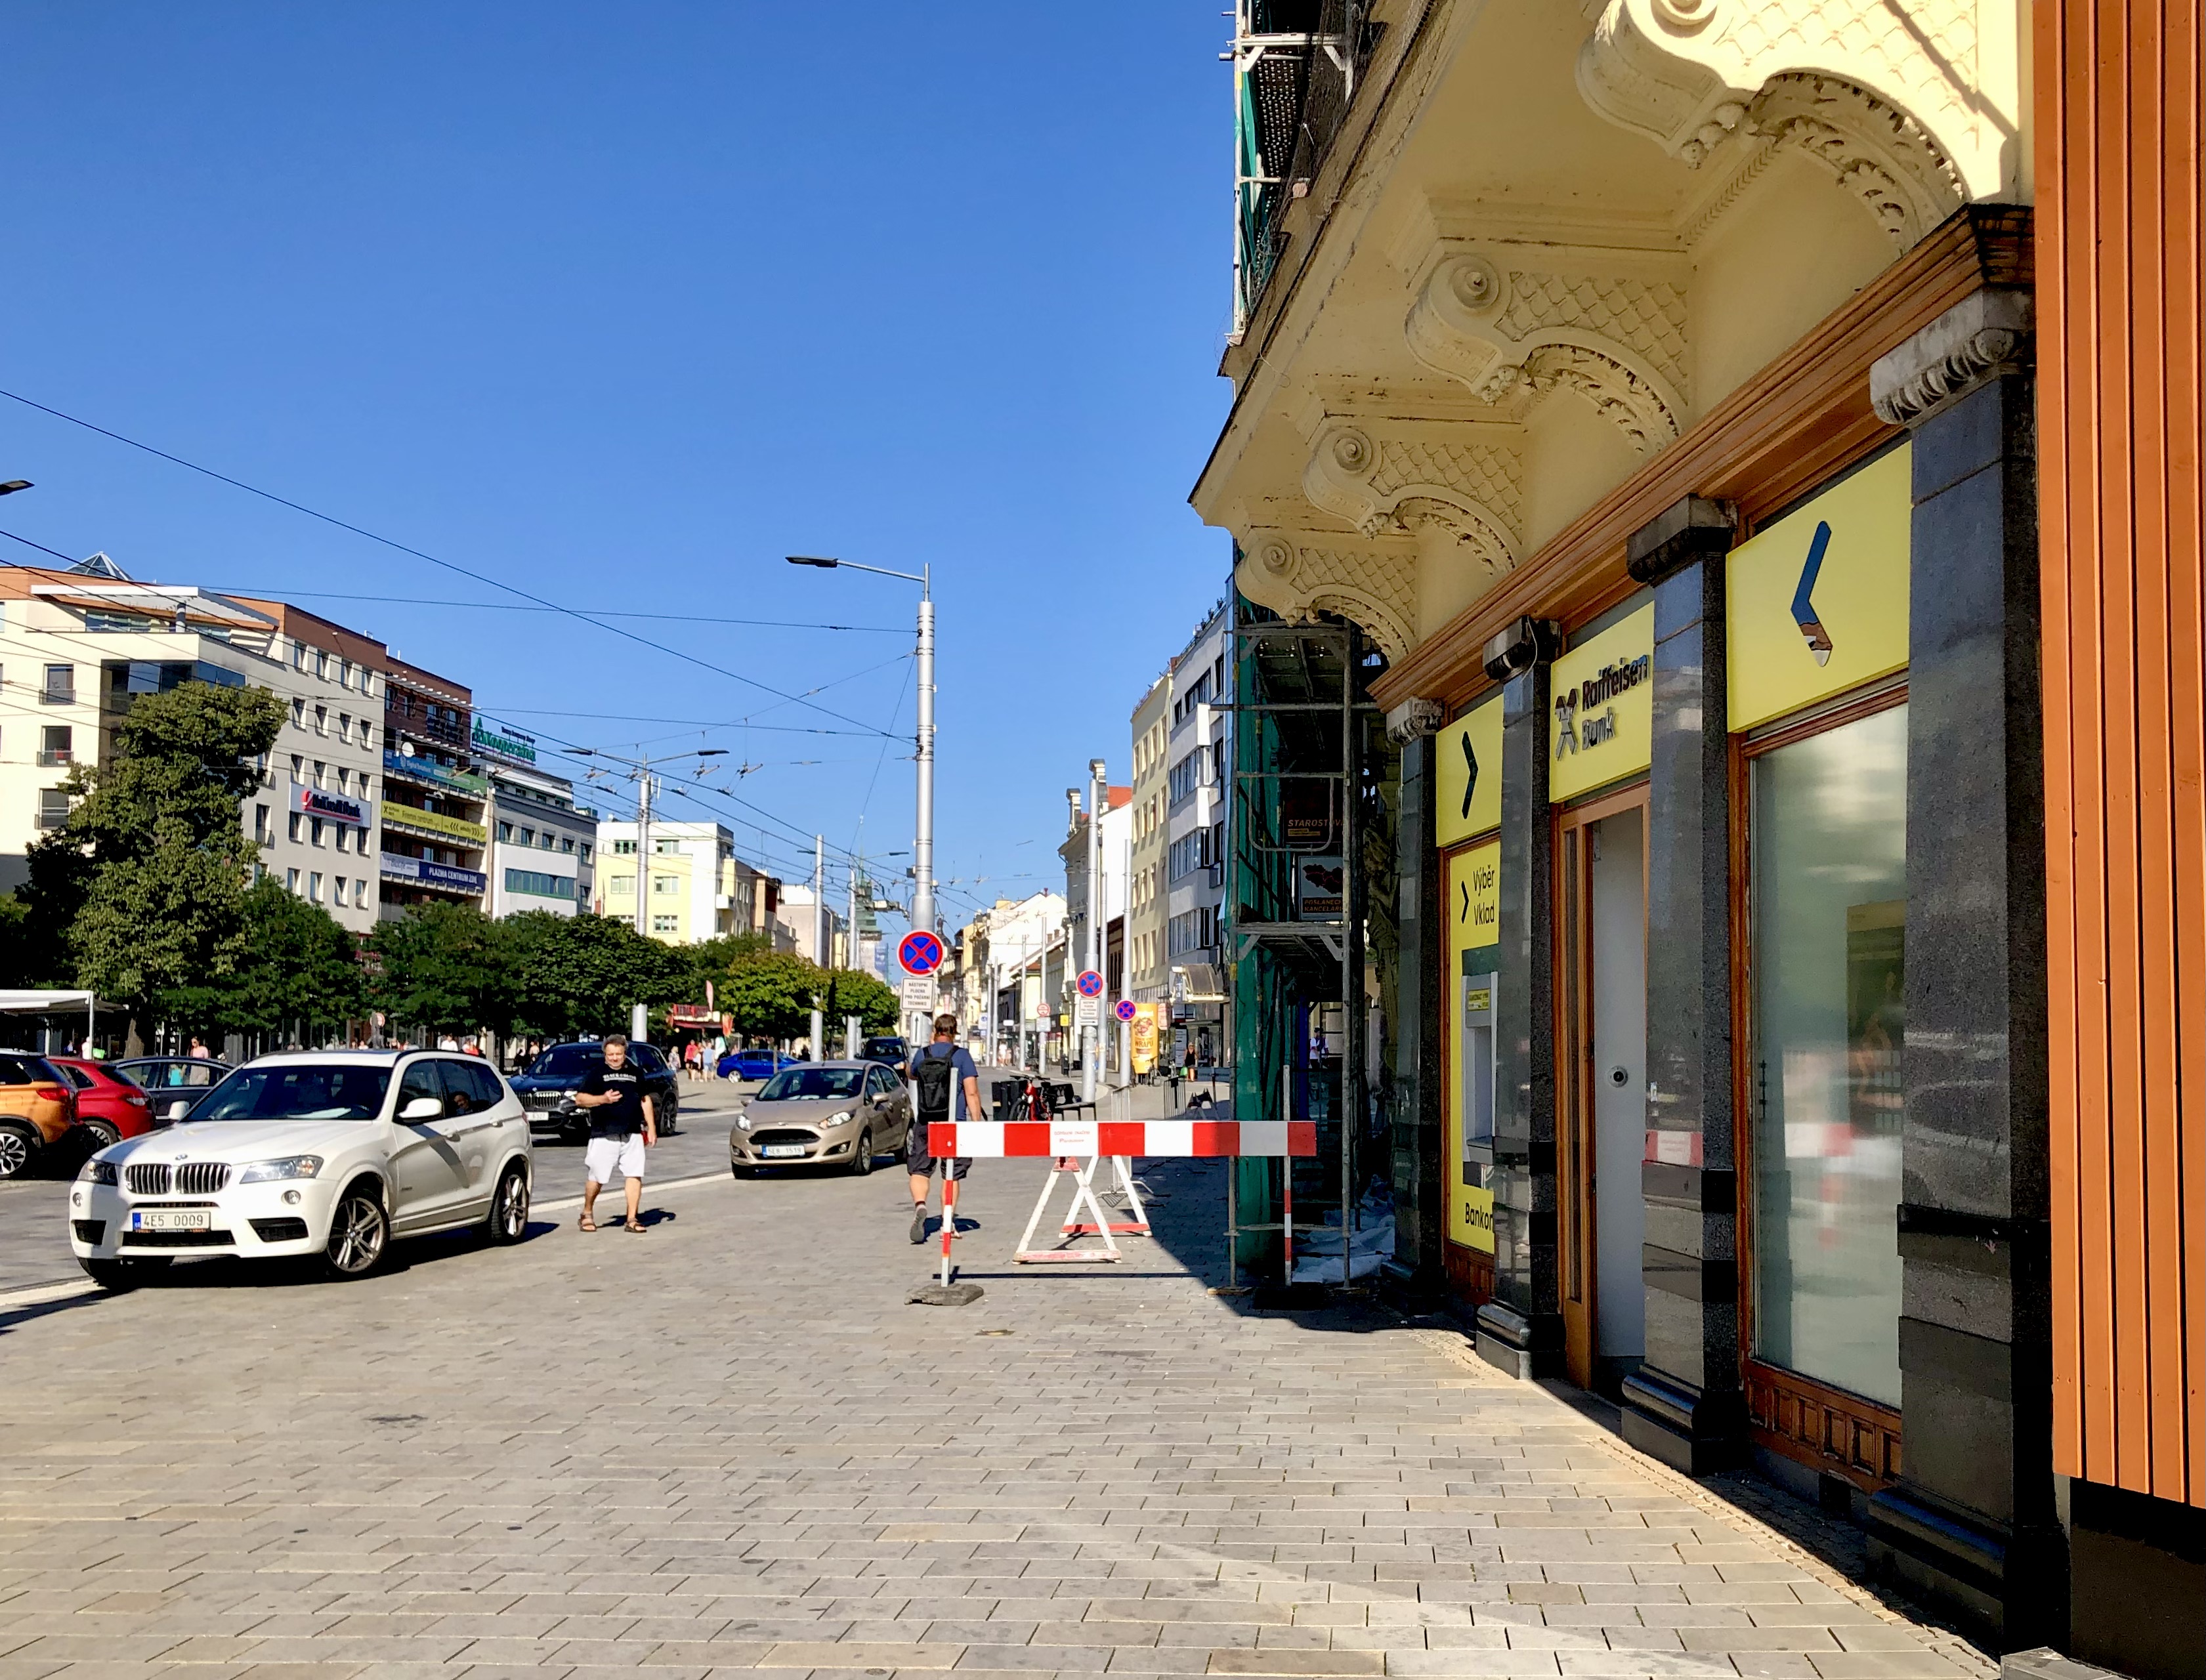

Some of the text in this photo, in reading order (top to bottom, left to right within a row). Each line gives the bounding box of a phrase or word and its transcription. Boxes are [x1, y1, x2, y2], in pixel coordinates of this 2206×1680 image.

[1582, 654, 1651, 712] Raiffeisen
[1582, 707, 1616, 751] Bank
[429, 867, 447, 878] PLAZMA
[448, 870, 468, 882] CENTRUM
[1473, 864, 1495, 896] Výběr
[1474, 899, 1495, 926] Vklad
[144, 1215, 165, 1227] 4E5
[174, 1215, 203, 1227] 0009
